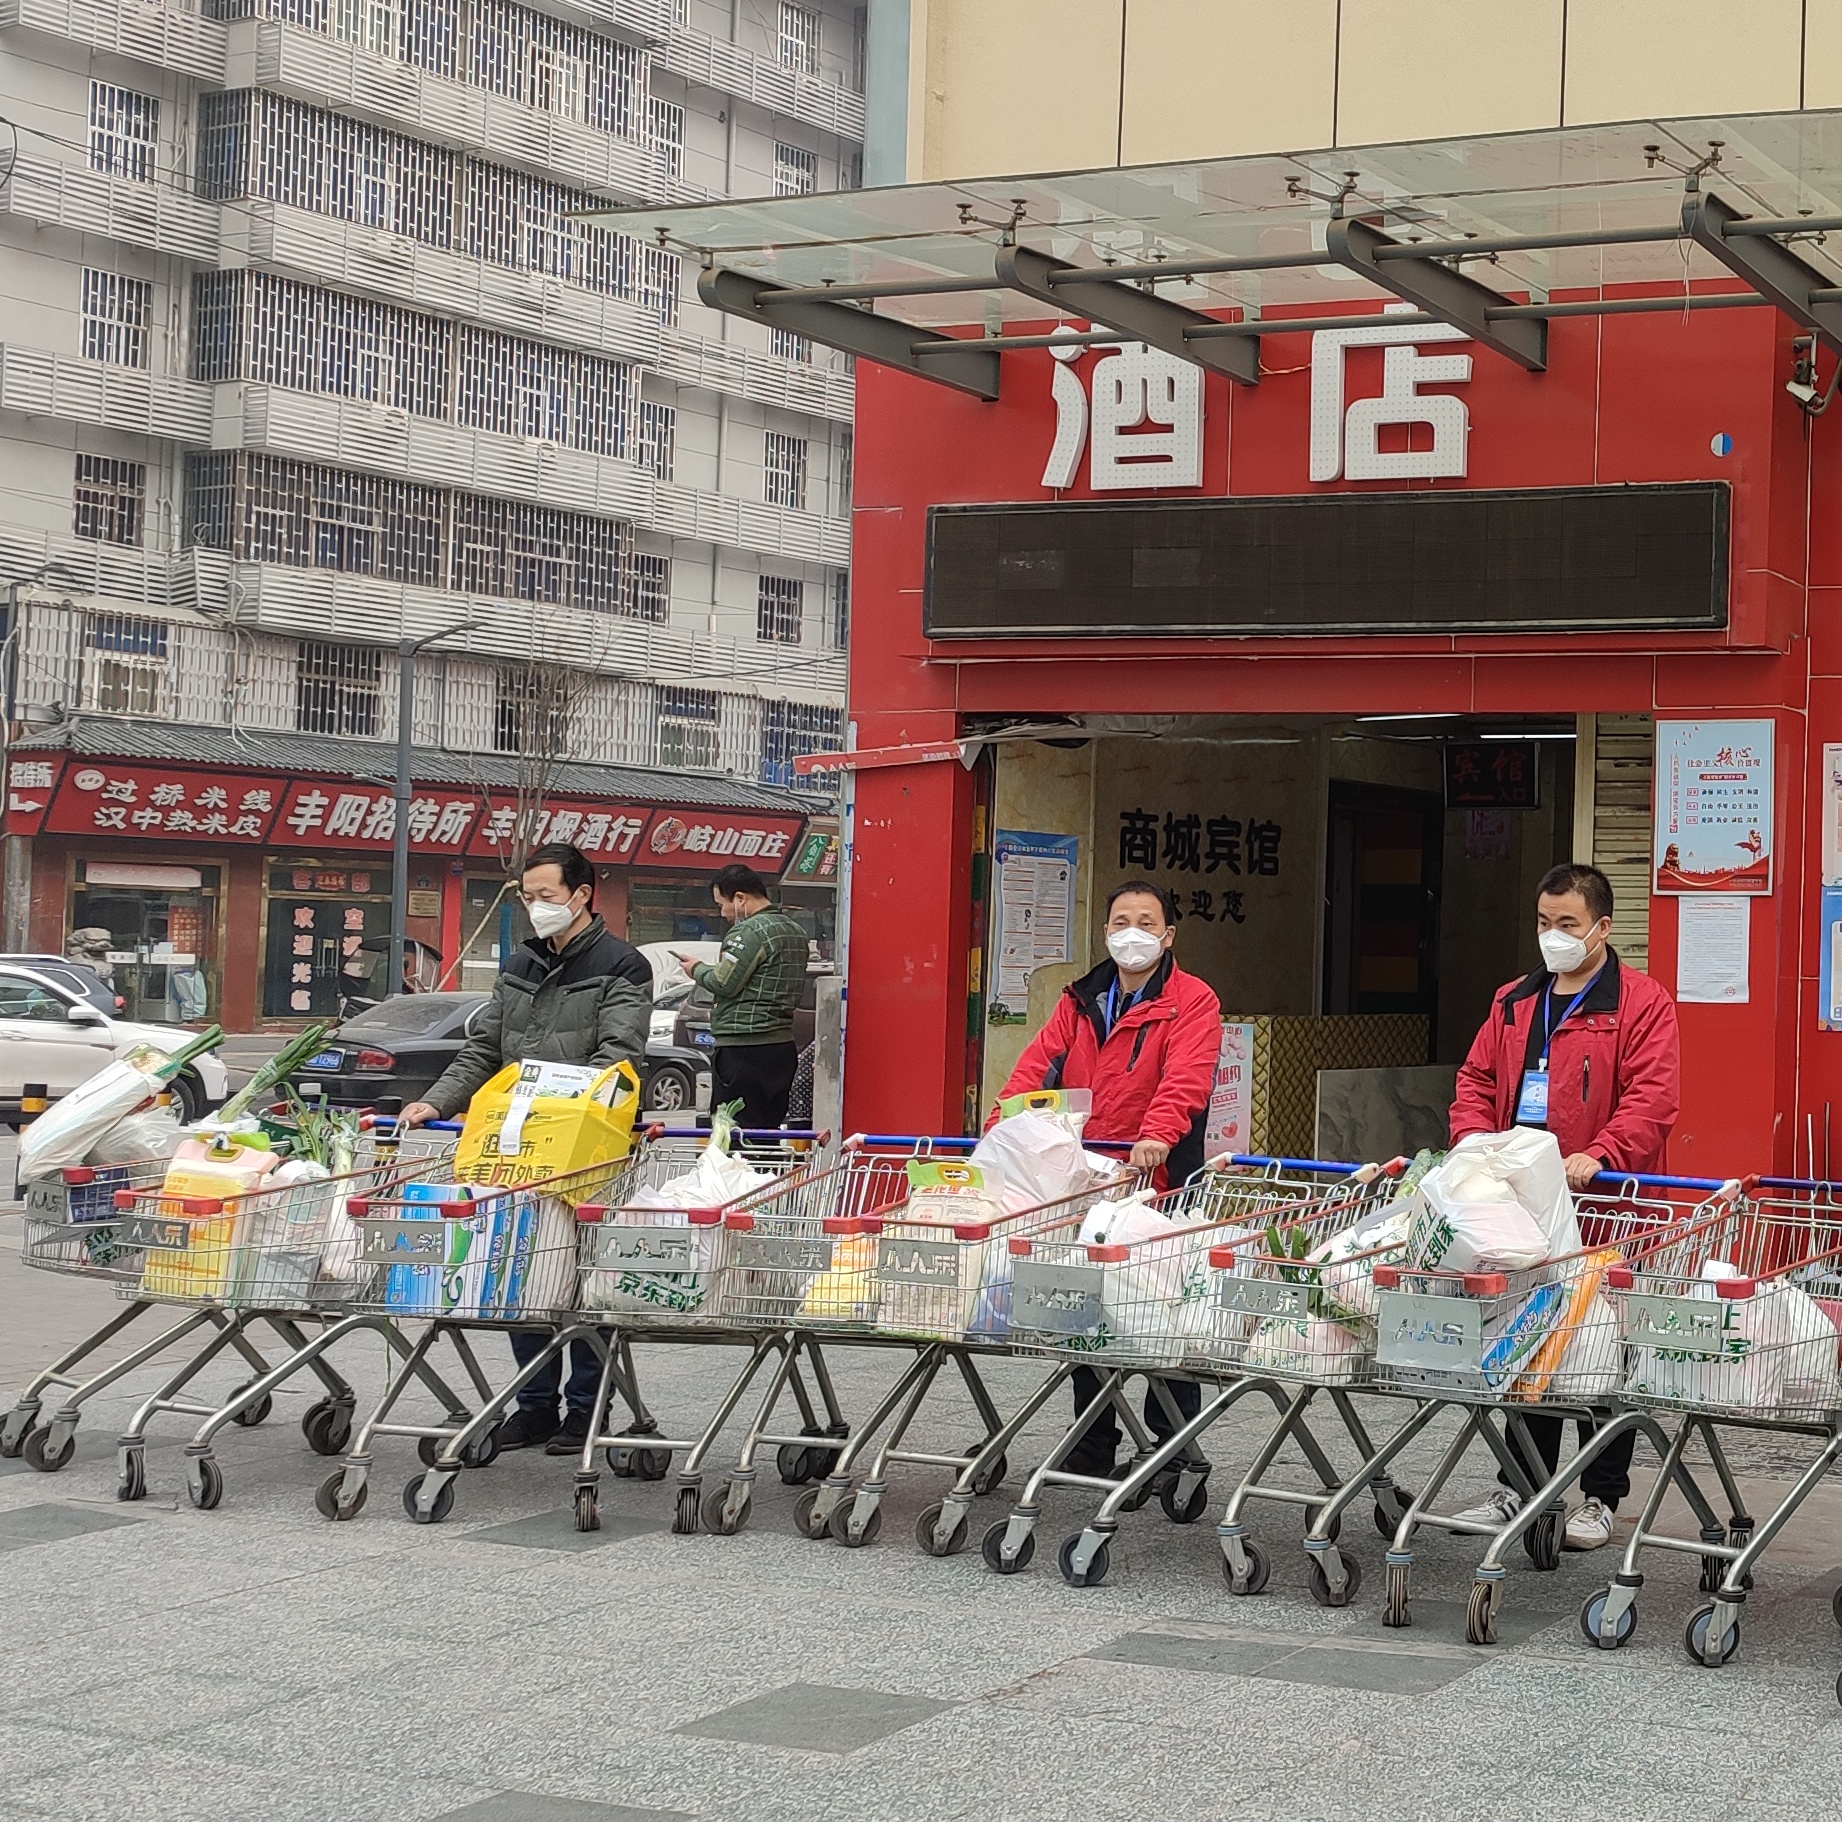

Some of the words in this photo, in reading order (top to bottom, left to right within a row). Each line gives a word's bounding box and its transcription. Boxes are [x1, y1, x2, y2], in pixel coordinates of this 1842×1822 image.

[1042, 304, 1474, 491] 酒店
[1451, 749, 1527, 783] 宾馆
[101, 778, 273, 812] 过桥米线
[93, 806, 263, 838] 汉中热米皮
[286, 790, 476, 845] 丰阳招待所
[1119, 807, 1282, 877] 商城宾馆
